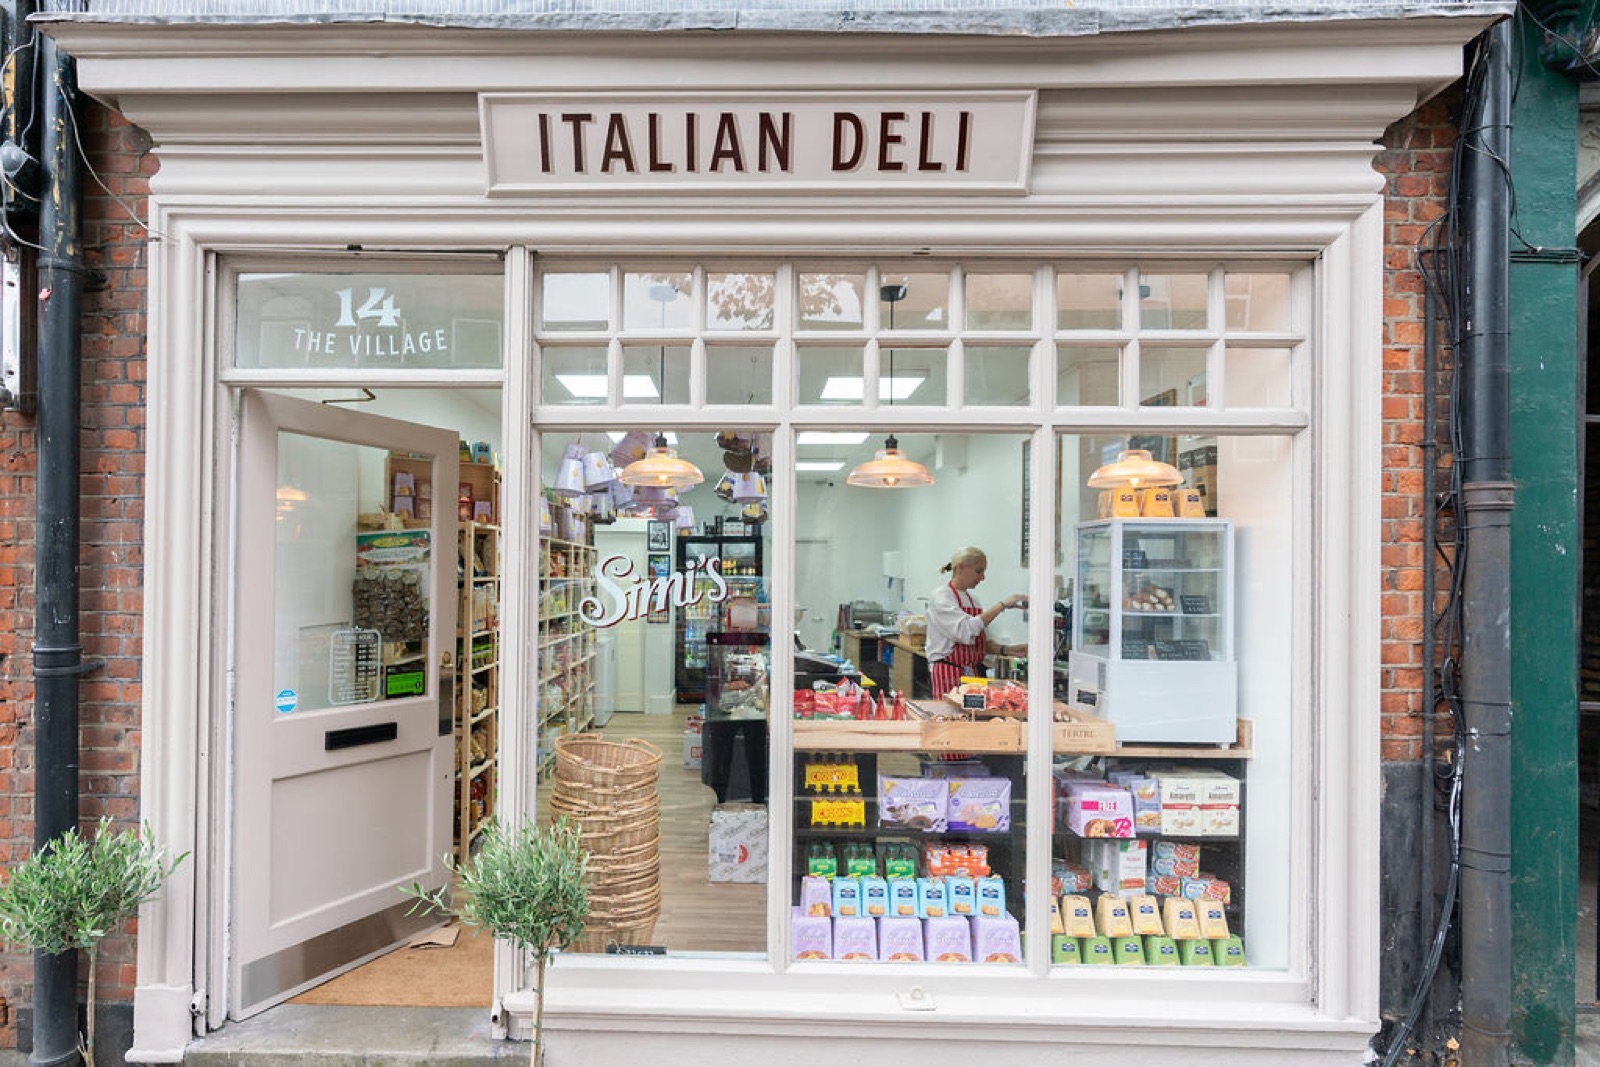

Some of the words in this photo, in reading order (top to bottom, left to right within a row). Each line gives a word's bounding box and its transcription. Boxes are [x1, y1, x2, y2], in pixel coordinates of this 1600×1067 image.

[537, 111, 793, 174] ITALIAN
[830, 110, 973, 173] DELI
[334, 287, 401, 327] 14
[293, 328, 337, 354] THE
[350, 328, 448, 356] VILLAGE
[578, 552, 728, 629] Simi's
